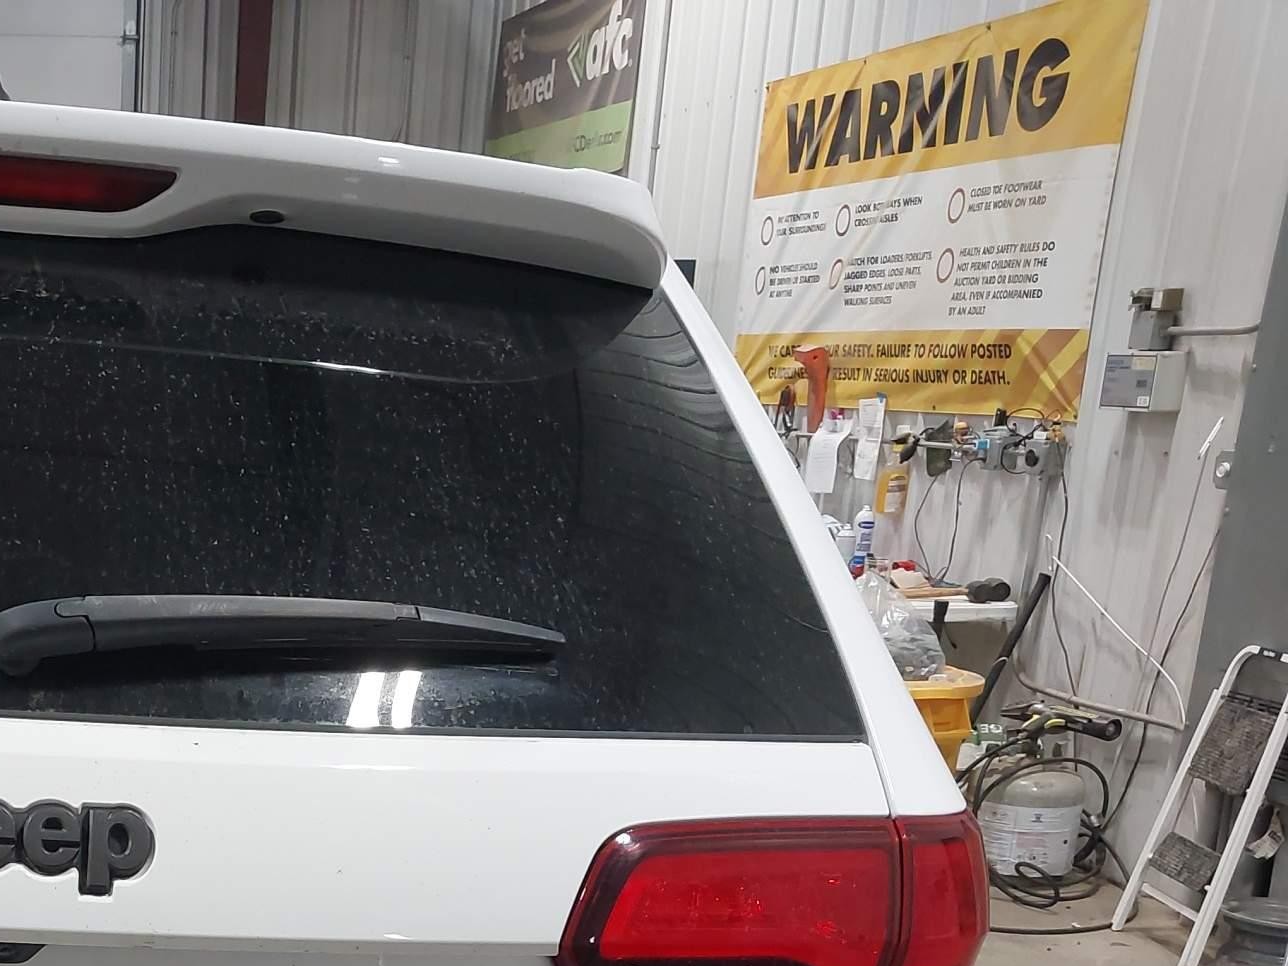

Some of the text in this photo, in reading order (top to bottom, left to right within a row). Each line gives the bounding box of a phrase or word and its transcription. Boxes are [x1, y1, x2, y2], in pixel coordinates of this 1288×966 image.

[787, 38, 1070, 174] WARNING
[970, 186, 992, 198] CLOSED
[1004, 180, 1043, 193] FOOTWEAR
[902, 196, 923, 207] WHEN
[992, 199, 1013, 210] WORN
[1015, 197, 1027, 207] ON
[1028, 195, 1047, 206] YARD
[959, 241, 1056, 257] HEALTH AND SAFETY RULES DO
[867, 256, 879, 265] FOR
[970, 261, 991, 271] PERMIT
[991, 259, 1022, 270] CHILDREN
[1022, 258, 1032, 268] IN
[1033, 257, 1049, 267] THE
[769, 265, 779, 274] NO
[844, 271, 868, 280] JAGGED
[954, 277, 980, 287] AUCTION
[997, 275, 1007, 284] OR
[1007, 273, 1039, 283] BIDDING
[969, 291, 985, 300] EVEN
[991, 289, 1043, 299] ACCOMPANIED
[948, 307, 957, 316] BY
[957, 306, 967, 316] AN
[842, 343, 874, 358] SAFETY.
[876, 343, 912, 359] FAILURE
[913, 343, 926, 359] TO
[927, 343, 969, 359] FOLLOW
[970, 343, 1012, 359] POSTED
[862, 367, 873, 382] IN
[874, 368, 910, 383] SERIOUS
[912, 369, 949, 385] INJURY
[952, 369, 967, 385] OR
[970, 369, 1011, 386] DEATH.
